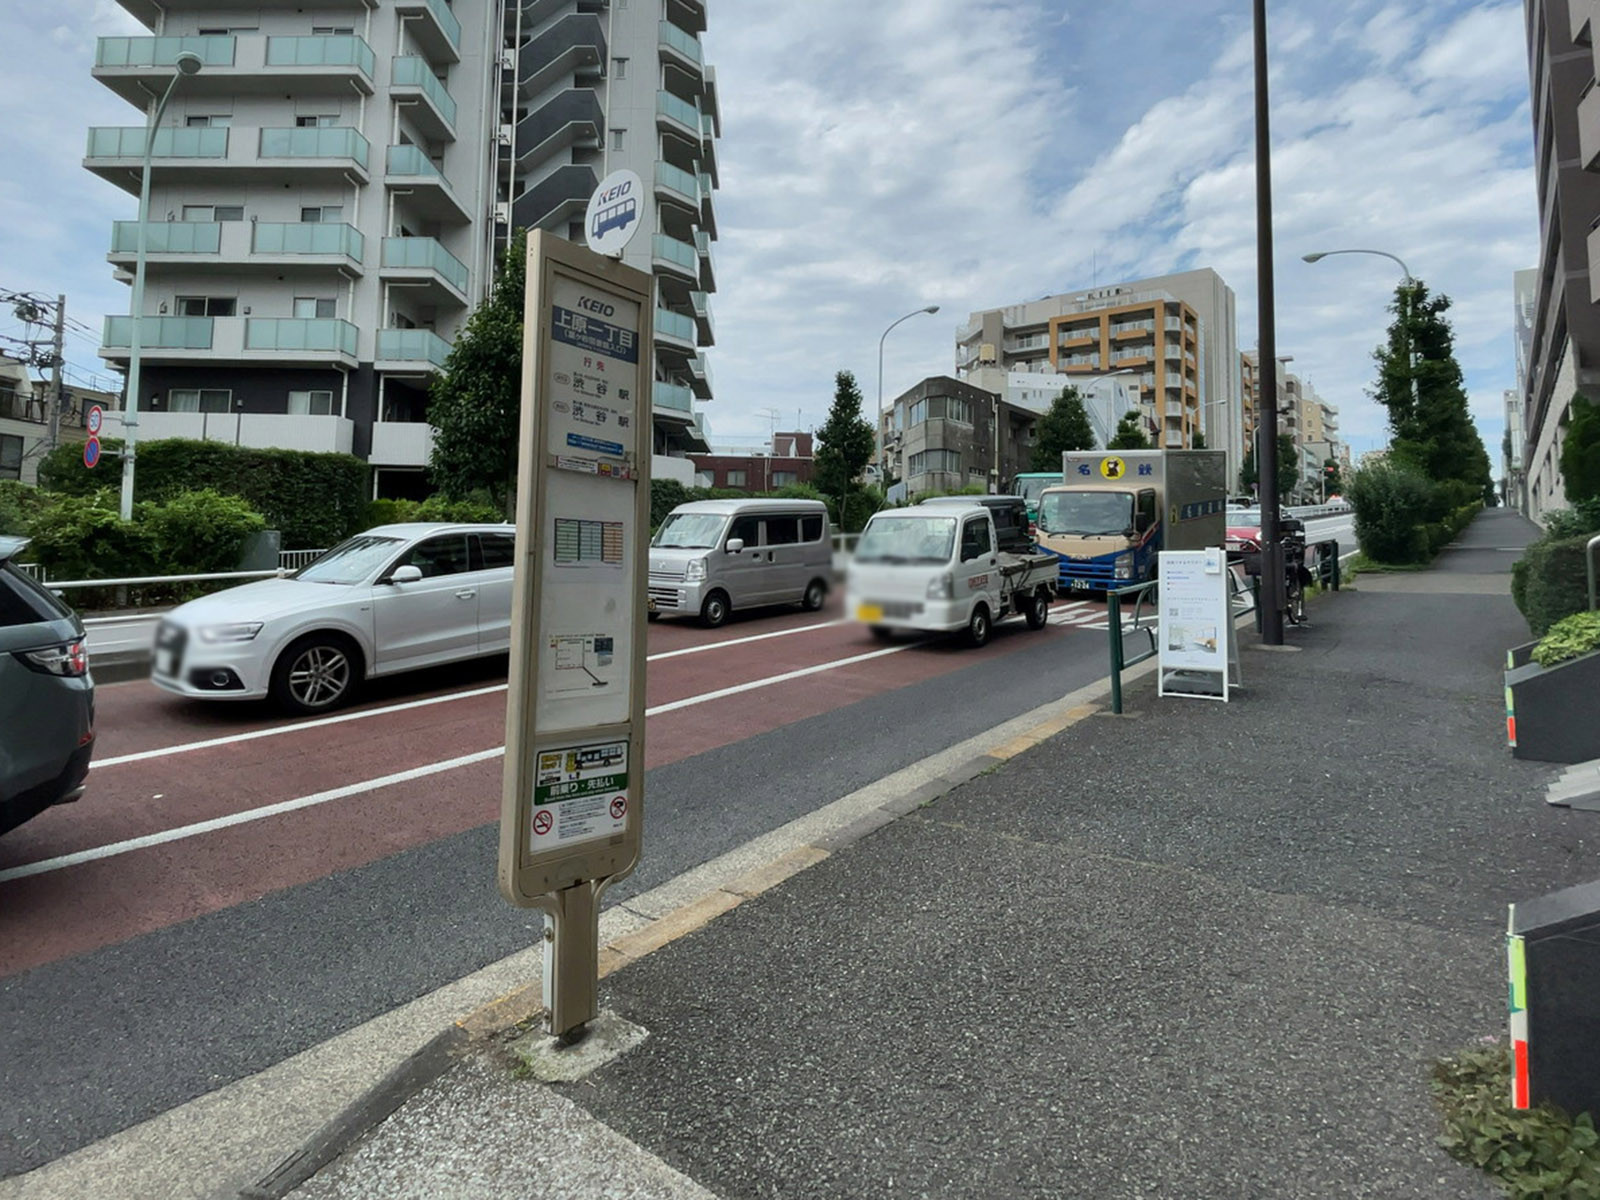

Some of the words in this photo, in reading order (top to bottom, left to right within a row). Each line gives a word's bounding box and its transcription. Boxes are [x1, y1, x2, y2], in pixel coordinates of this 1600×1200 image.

[598, 181, 631, 206] KEIO
[578, 296, 615, 317] KEIO
[554, 310, 633, 348] 上原一丁目
